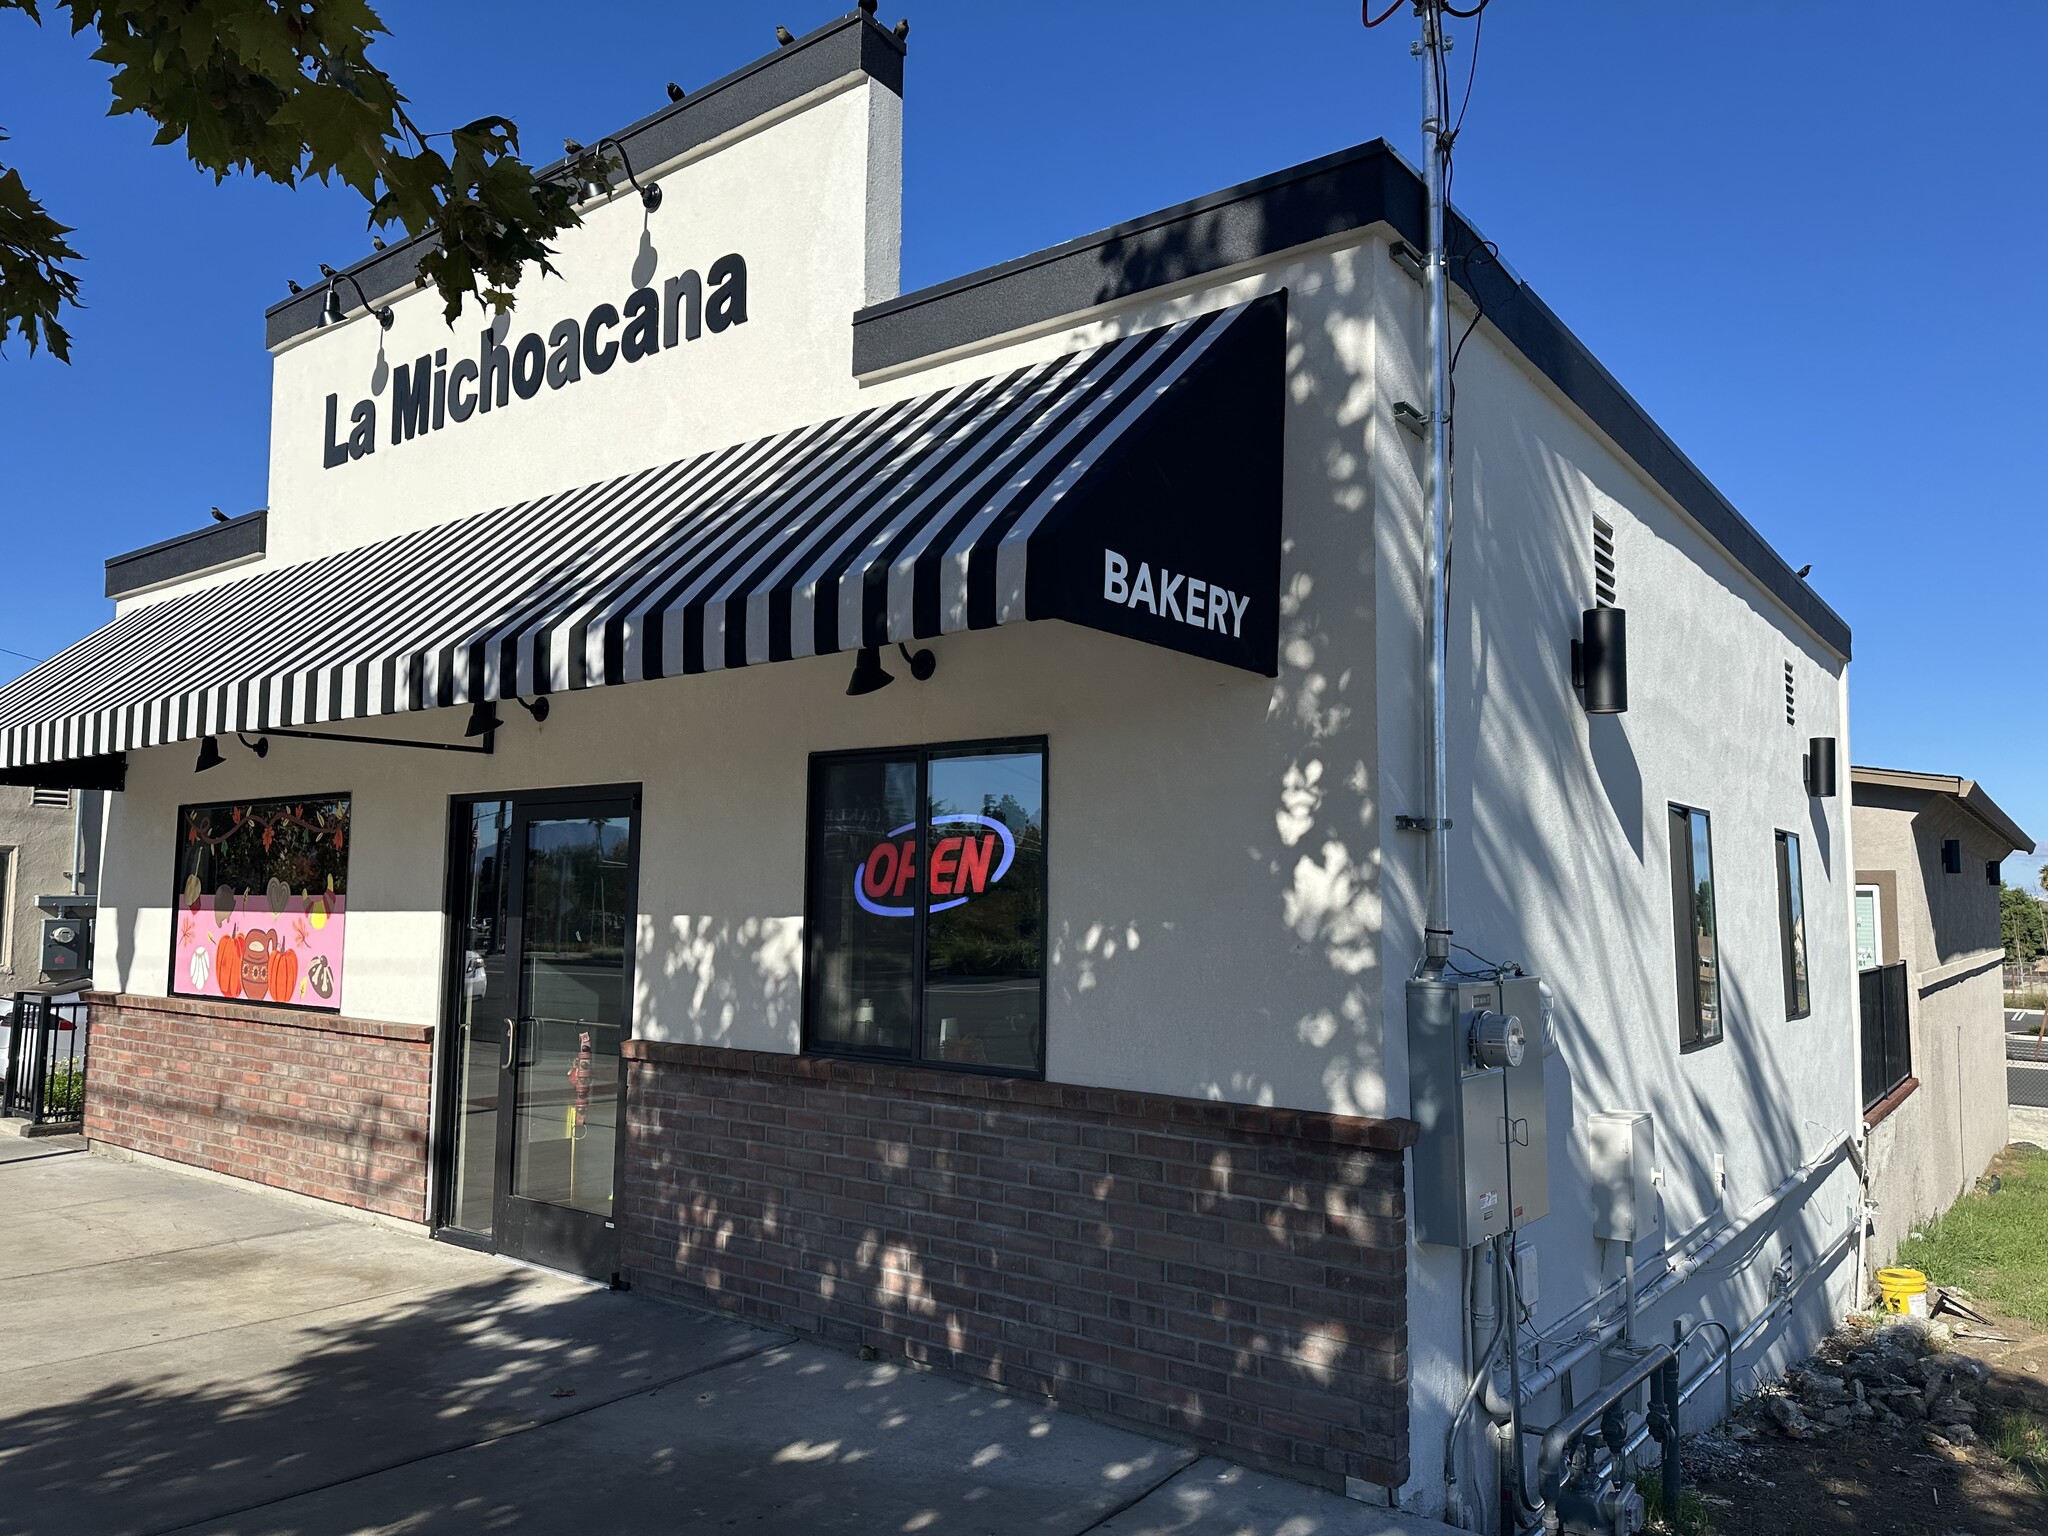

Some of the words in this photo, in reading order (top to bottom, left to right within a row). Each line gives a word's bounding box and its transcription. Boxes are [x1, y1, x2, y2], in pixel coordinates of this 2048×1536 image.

[323, 393, 376, 469] La
[391, 253, 748, 446] Michoacana
[1104, 548, 1251, 639] BAKERY
[864, 834, 995, 898] OPEN
